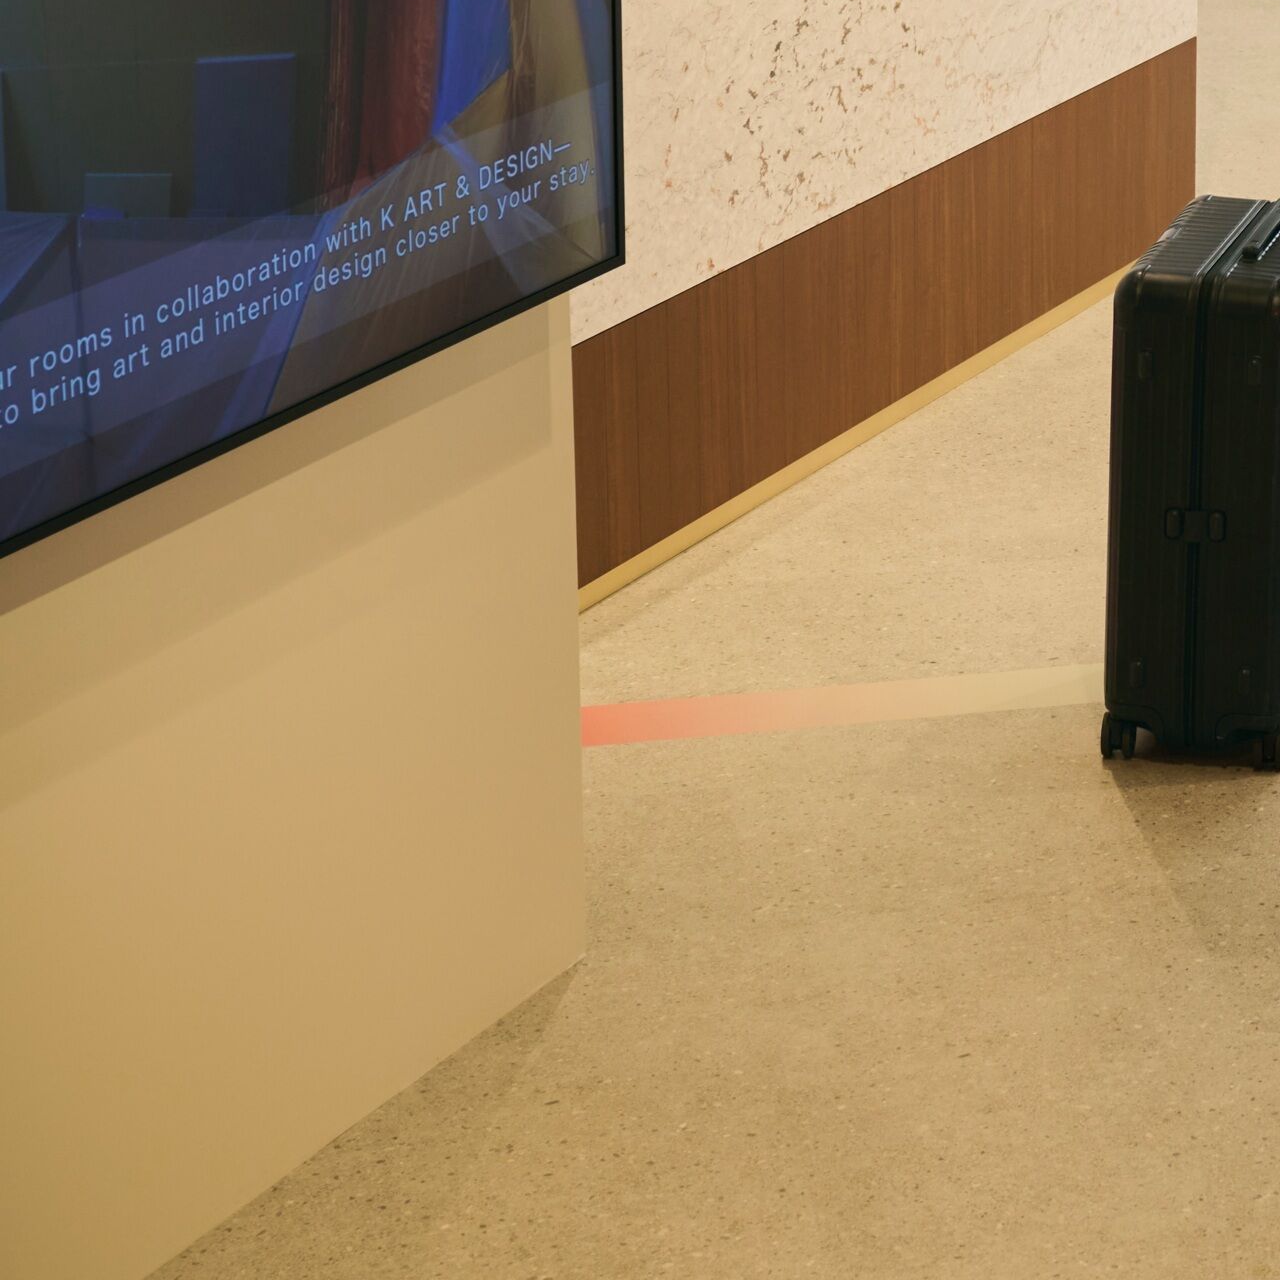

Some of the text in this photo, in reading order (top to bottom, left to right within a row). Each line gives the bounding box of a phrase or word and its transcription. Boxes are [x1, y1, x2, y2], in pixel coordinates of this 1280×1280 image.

[0, 159, 595, 428] o bring art and interior design closer to your stay.
[30, 327, 112, 377] rooms
[124, 313, 145, 338] in
[157, 242, 316, 323] collaboration
[326, 216, 371, 254] with
[380, 204, 395, 231] K
[404, 182, 447, 221] ART
[455, 175, 470, 199] &
